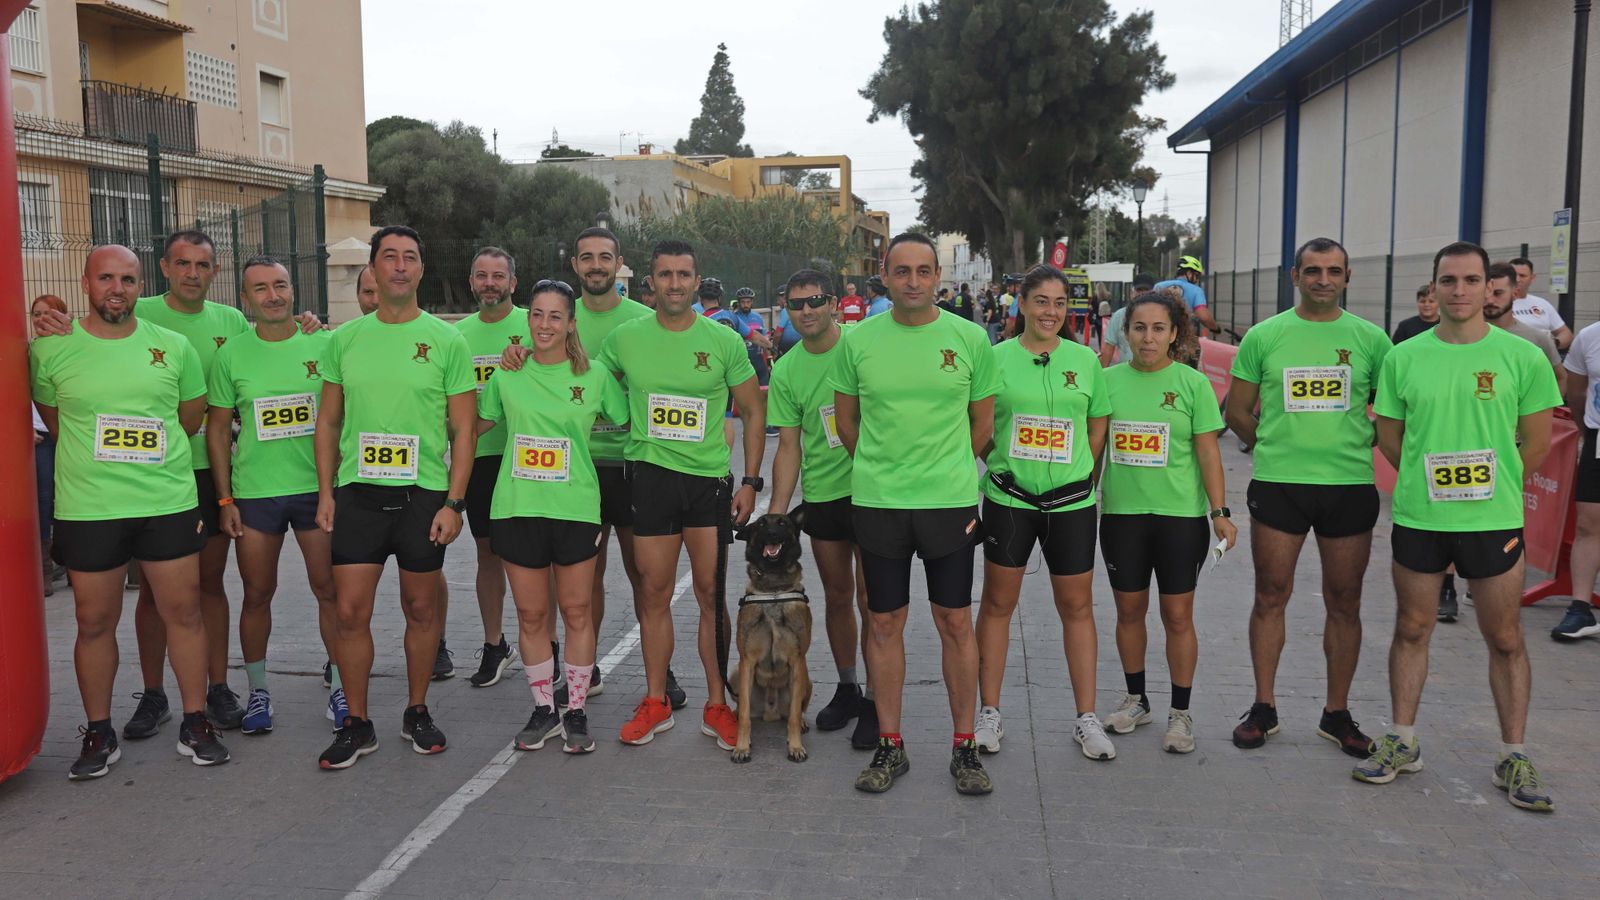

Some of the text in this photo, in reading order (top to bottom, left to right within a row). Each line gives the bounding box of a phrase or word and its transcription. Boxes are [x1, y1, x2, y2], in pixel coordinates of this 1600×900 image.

[1292, 381, 1341, 396] 382
[262, 406, 309, 426] 296
[653, 408, 697, 426] 306
[103, 429, 157, 448] 258
[1019, 428, 1065, 448] 352
[1115, 434, 1160, 452] 254
[364, 447, 408, 464] 381
[525, 449, 555, 467] 30
[1435, 465, 1490, 485] 383
[1533, 472, 1558, 495] Roque
